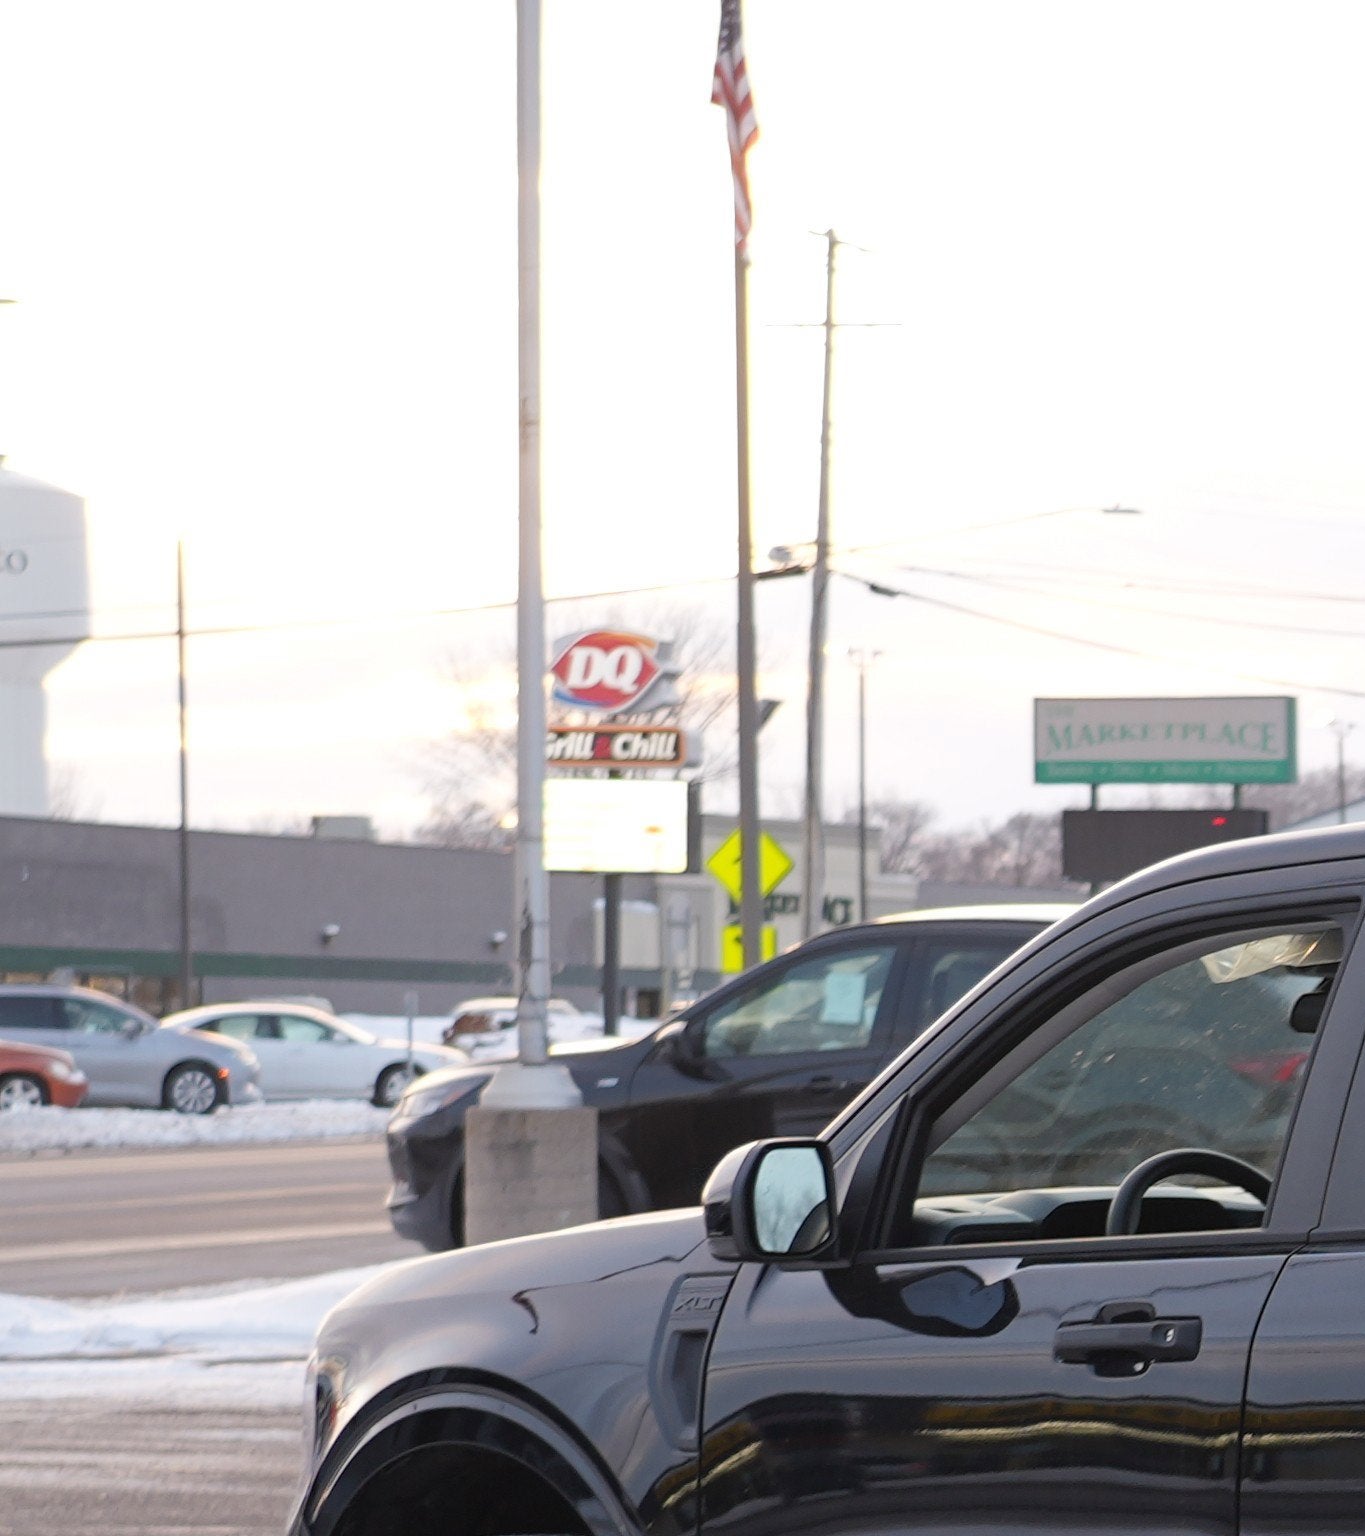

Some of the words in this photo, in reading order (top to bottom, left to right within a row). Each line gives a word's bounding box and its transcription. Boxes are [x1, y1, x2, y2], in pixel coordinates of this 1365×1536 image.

[565, 646, 644, 694] DQ
[612, 732, 677, 761] Chill
[1046, 721, 1278, 756] MARKETPLACE
